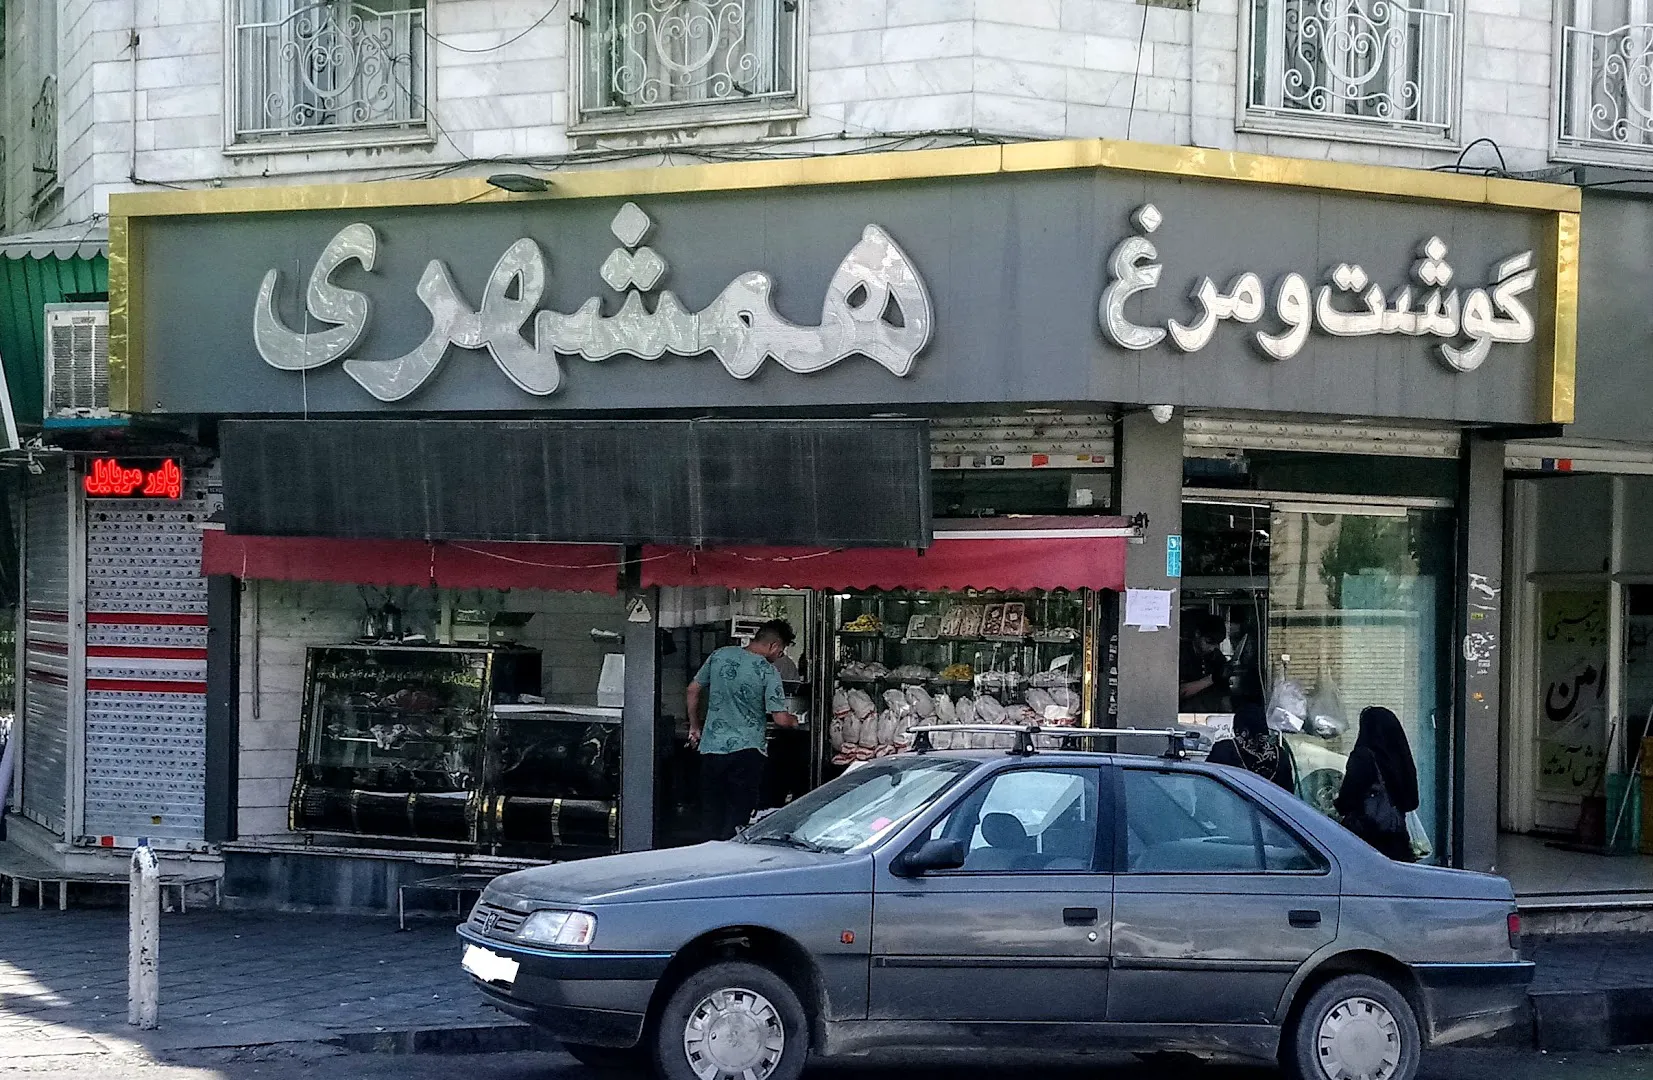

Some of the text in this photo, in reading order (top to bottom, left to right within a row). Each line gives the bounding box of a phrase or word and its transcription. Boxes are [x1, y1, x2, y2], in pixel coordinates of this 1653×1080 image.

[253, 201, 935, 402] همشهری
[1099, 202, 1538, 373] گوشت و مرغ
[85, 458, 142, 494] موبایل
[143, 458, 181, 499] پاور
